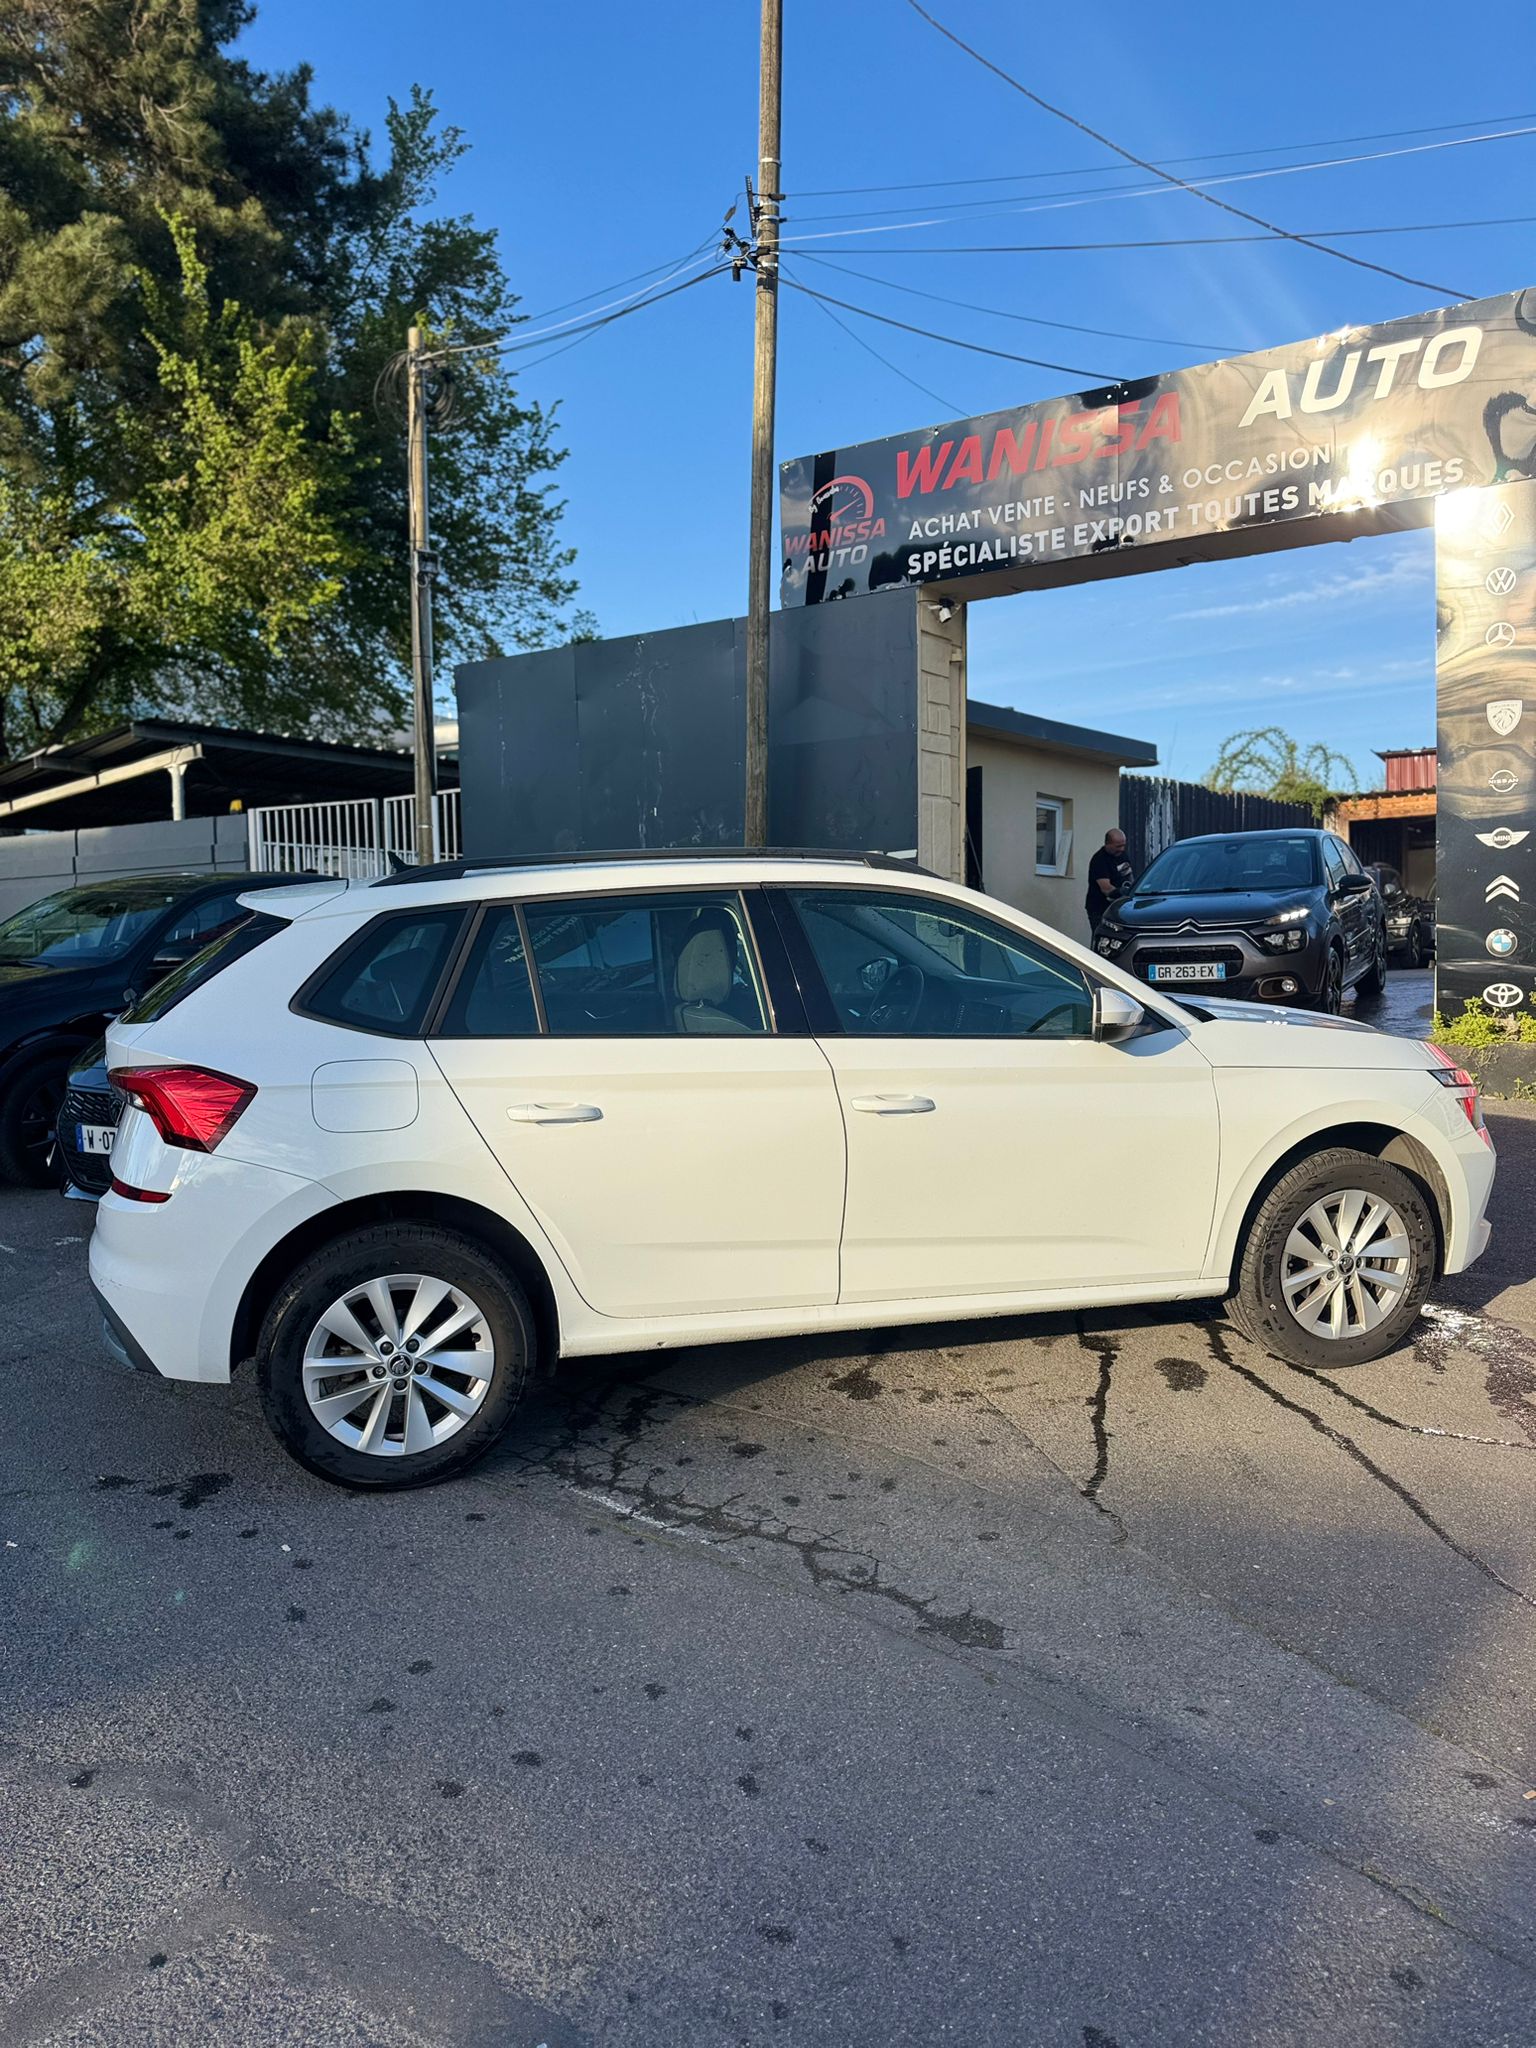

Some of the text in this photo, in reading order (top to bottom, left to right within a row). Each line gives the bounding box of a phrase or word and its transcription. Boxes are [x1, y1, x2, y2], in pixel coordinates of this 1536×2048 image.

[896, 326, 1484, 499] WANISSA AUTO
[908, 510, 981, 540] ACHAT
[988, 496, 1055, 525] VENTE
[1079, 477, 1150, 509] NEUFS
[1158, 474, 1174, 495] &
[1182, 443, 1330, 489] OCCASION
[908, 527, 1066, 575] SPÉCIALISTE
[1074, 506, 1180, 546] EXPORT
[1188, 485, 1299, 525] TOUTES
[785, 517, 886, 557] WANISSA
[801, 544, 868, 574] AUTO
